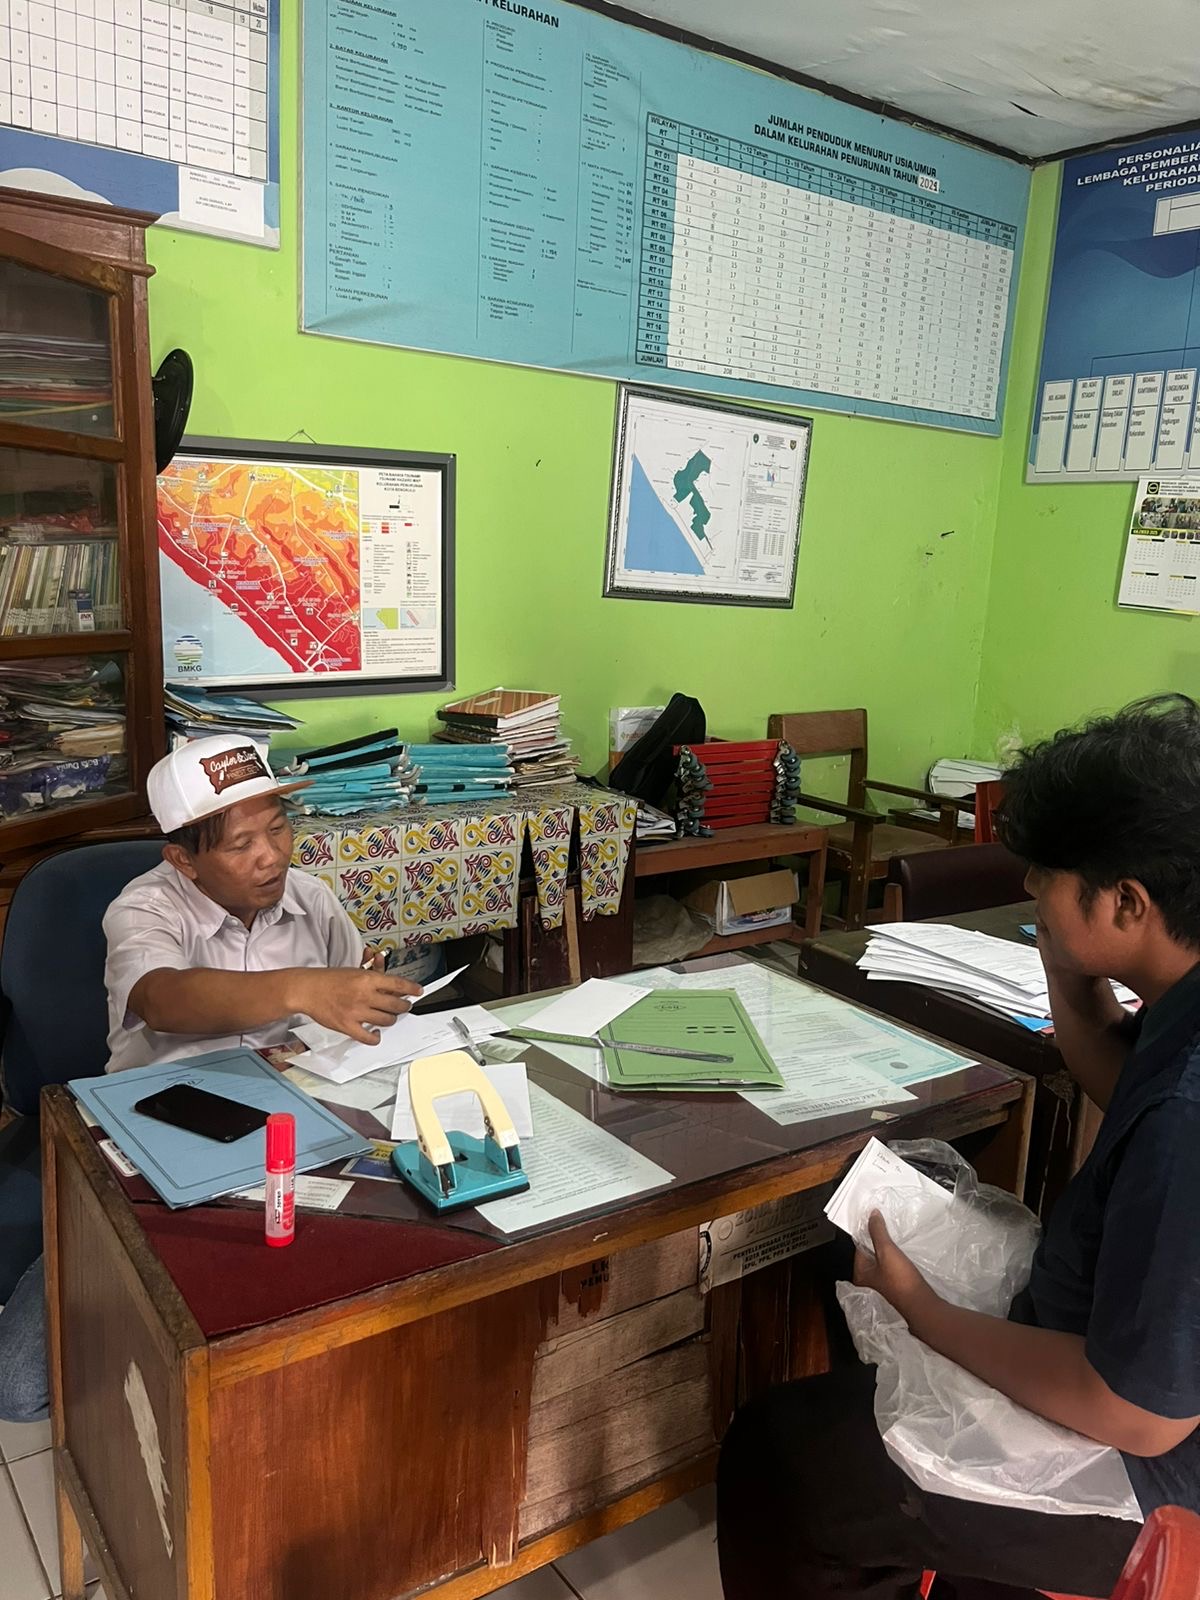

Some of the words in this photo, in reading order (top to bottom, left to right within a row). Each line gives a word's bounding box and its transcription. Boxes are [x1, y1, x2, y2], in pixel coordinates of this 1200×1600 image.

[492, 0, 559, 28] KELURAHAN
[256, 20, 261, 28] 20
[650, 116, 677, 130] WILAYAH
[703, 133, 719, 142] Tahun
[768, 114, 804, 135] JUMLAH
[807, 127, 852, 150] PENDUDUK
[854, 143, 893, 163] MENURUT
[895, 157, 937, 178] USIA/UMUR
[754, 124, 785, 143] DALAM
[788, 134, 838, 160] KELURAHAN
[841, 152, 891, 176] PENURUNAN
[893, 168, 919, 184] TAHUN
[754, 149, 768, 159] Tahun
[1077, 166, 1138, 186] LEMBAGA
[1142, 154, 1200, 172] PEMBER
[1123, 164, 1200, 186] KELURAHA
[641, 352, 664, 363] JUMLAH
[178, 665, 202, 673] BMKG
[792, 1234, 806, 1243] 2012
